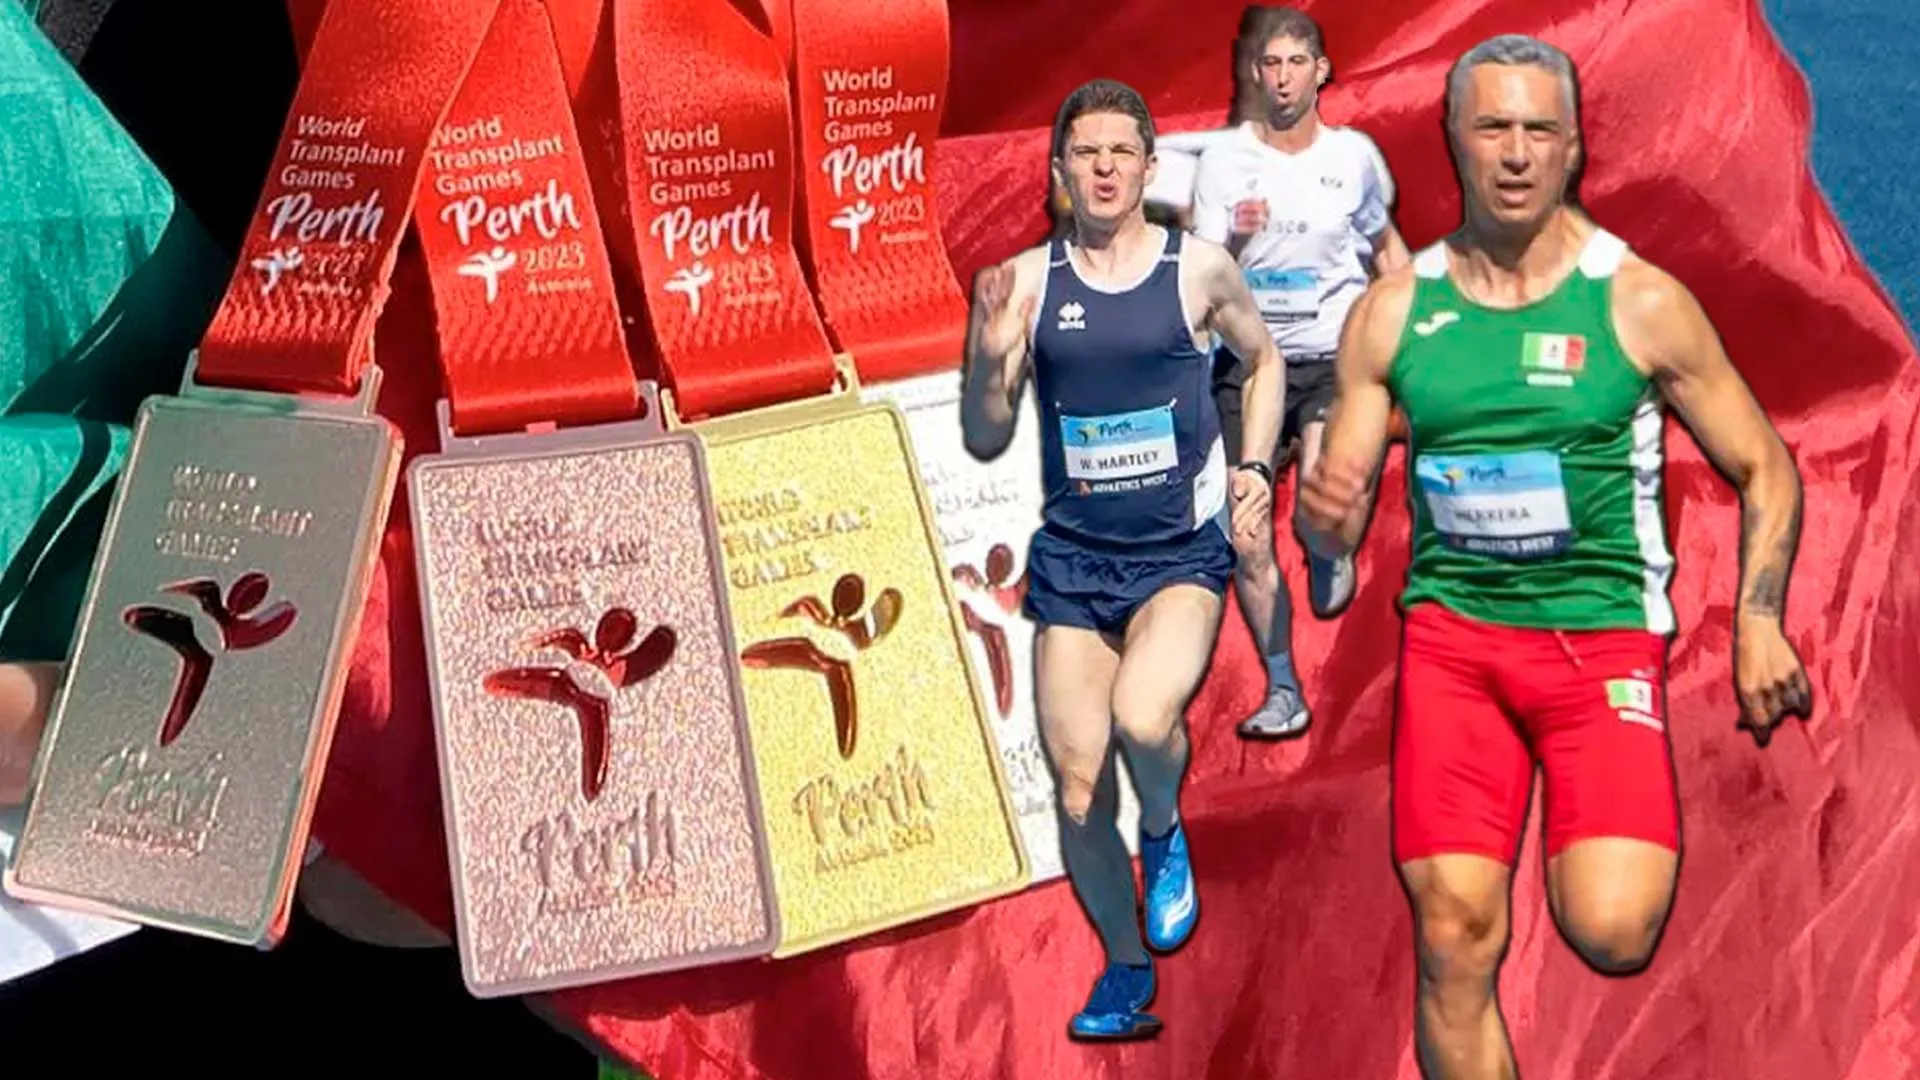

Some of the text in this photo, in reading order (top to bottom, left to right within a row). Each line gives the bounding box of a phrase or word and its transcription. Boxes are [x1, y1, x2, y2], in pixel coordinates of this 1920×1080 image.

[823, 66, 892, 92] World
[824, 91, 935, 119] Transplant
[298, 116, 365, 138] World
[644, 124, 720, 153] World
[824, 119, 893, 143] Games
[289, 140, 404, 168] Transplant
[430, 134, 564, 170] Transplant
[644, 149, 774, 178] Transplant
[822, 132, 925, 198] Perth
[281, 164, 355, 189] Games
[436, 167, 523, 196] Games
[650, 179, 731, 205] Games
[267, 188, 384, 248] Perth
[440, 178, 580, 245] Perth
[877, 195, 925, 226] 2023
[650, 191, 773, 260] Perth
[522, 244, 585, 273] 2023
[720, 255, 775, 288] 2023
[1080, 450, 1159, 471] W. HARTLEY
[1141, 473, 1169, 488] WEST
[791, 743, 937, 846] Perth
[520, 791, 677, 889] Perth
